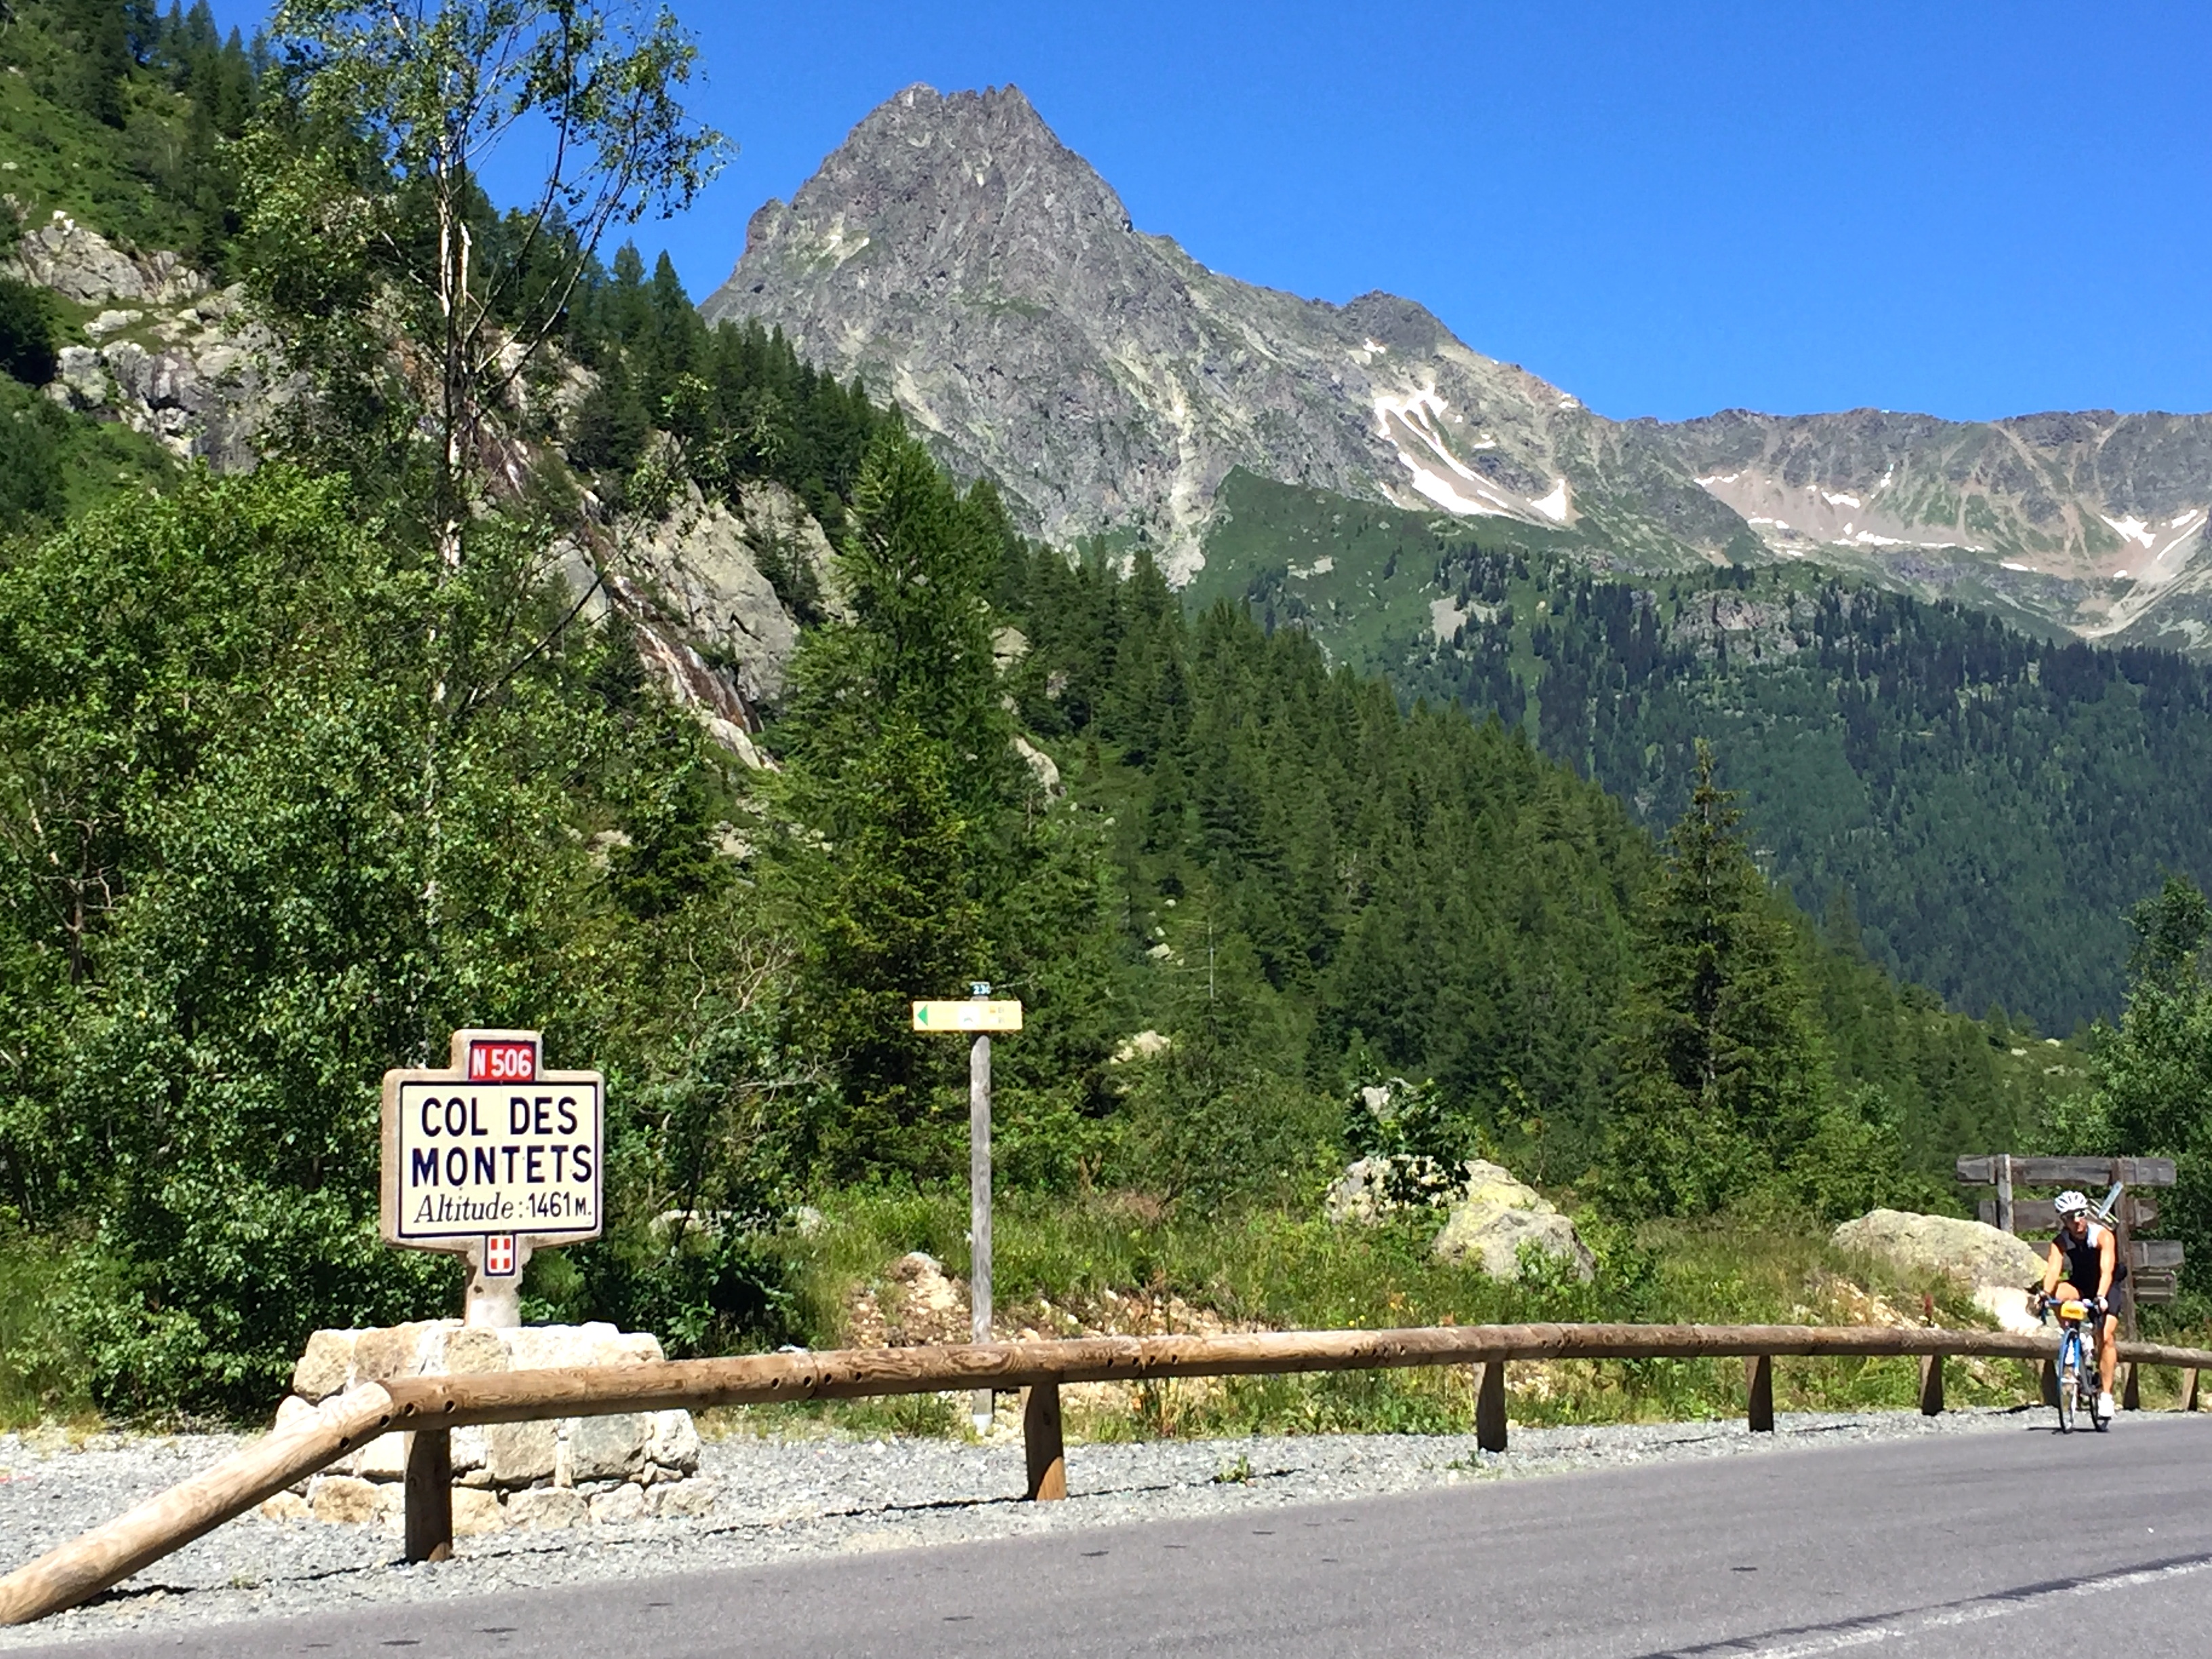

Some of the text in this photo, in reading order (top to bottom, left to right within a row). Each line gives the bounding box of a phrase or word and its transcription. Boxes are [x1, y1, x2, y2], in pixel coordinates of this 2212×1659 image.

[473, 1048, 532, 1078] N 506
[422, 1097, 577, 1137] COL DES
[412, 1144, 592, 1187] MONTETS
[528, 1191, 570, 1218] 1461
